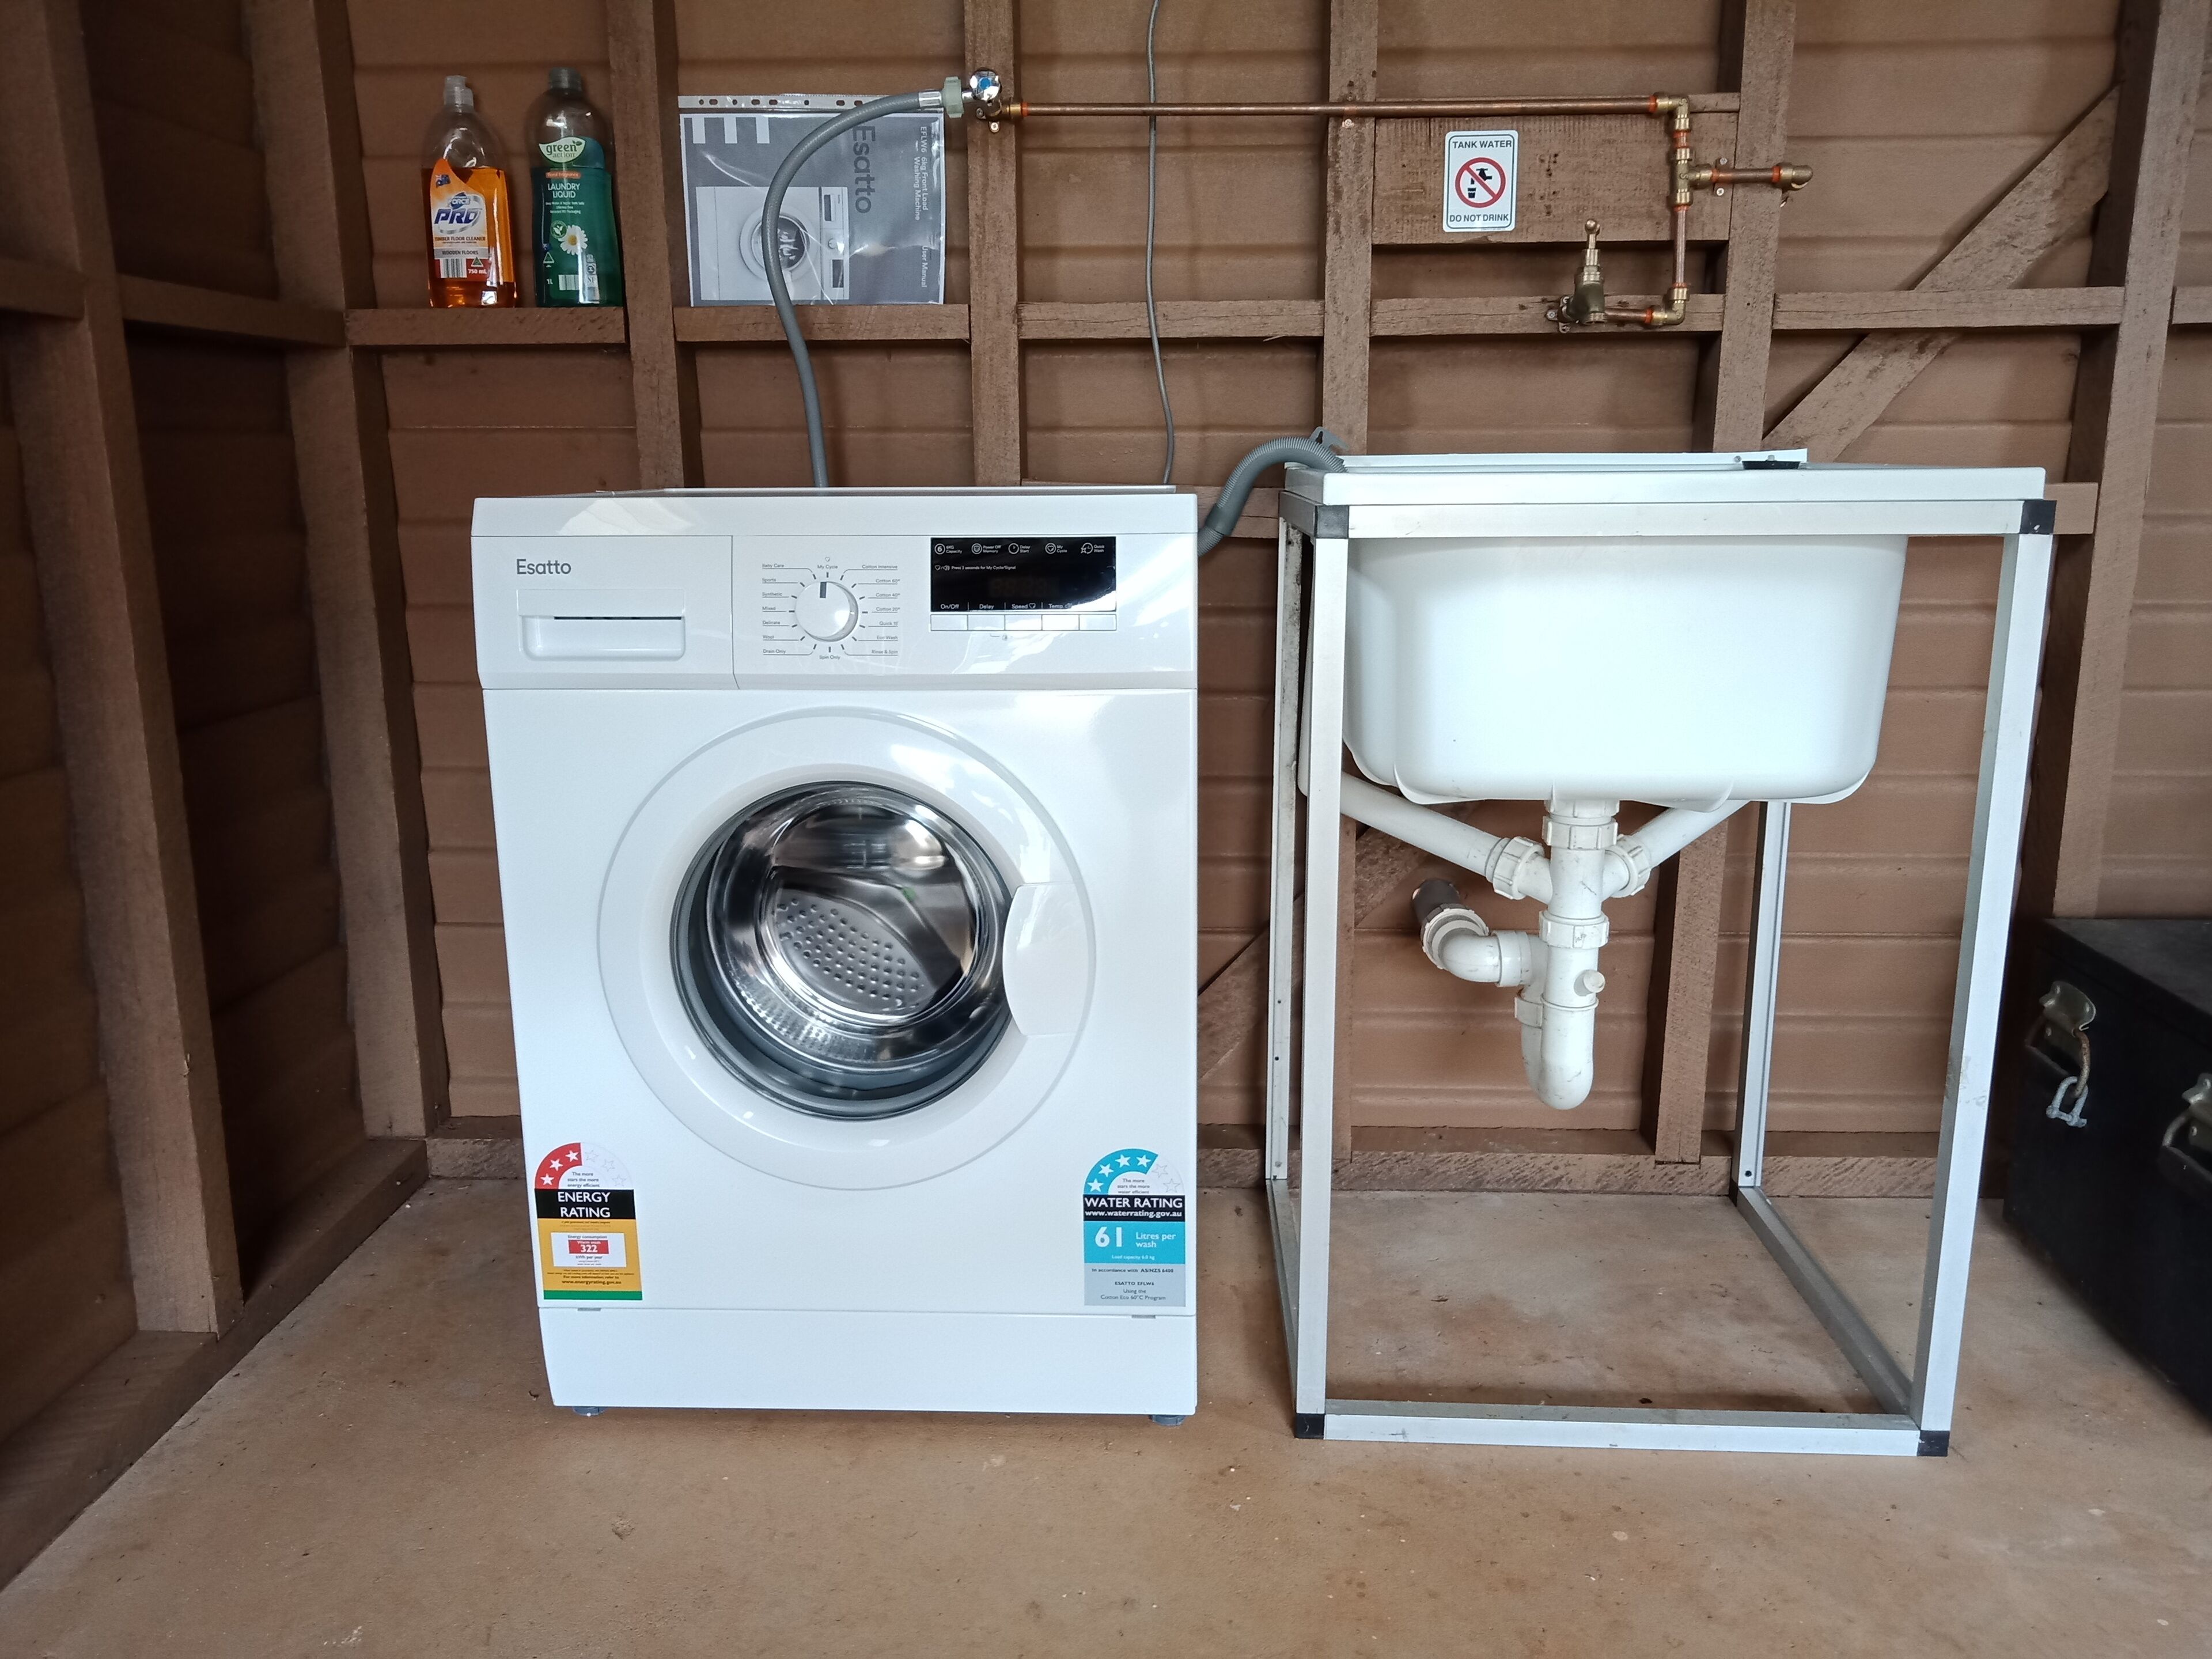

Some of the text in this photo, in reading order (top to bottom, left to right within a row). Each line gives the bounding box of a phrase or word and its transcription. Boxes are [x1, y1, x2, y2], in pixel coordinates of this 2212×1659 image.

[1479, 140, 1512, 148] WATER
[546, 144, 577, 156] green
[921, 156, 929, 171] 6kg
[853, 125, 876, 214] Esatto
[547, 183, 581, 191] LAUNDRY
[552, 191, 577, 199] LIQUID
[516, 558, 572, 575] Esatto
[558, 1191, 611, 1203] ENERGY
[1085, 1198, 1183, 1208] WATER RATING
[560, 1207, 611, 1218] RATING
[1085, 1210, 1182, 1218] www.waterrating.gov.au
[1161, 1233, 1176, 1241] per
[580, 1245, 598, 1253] 322
